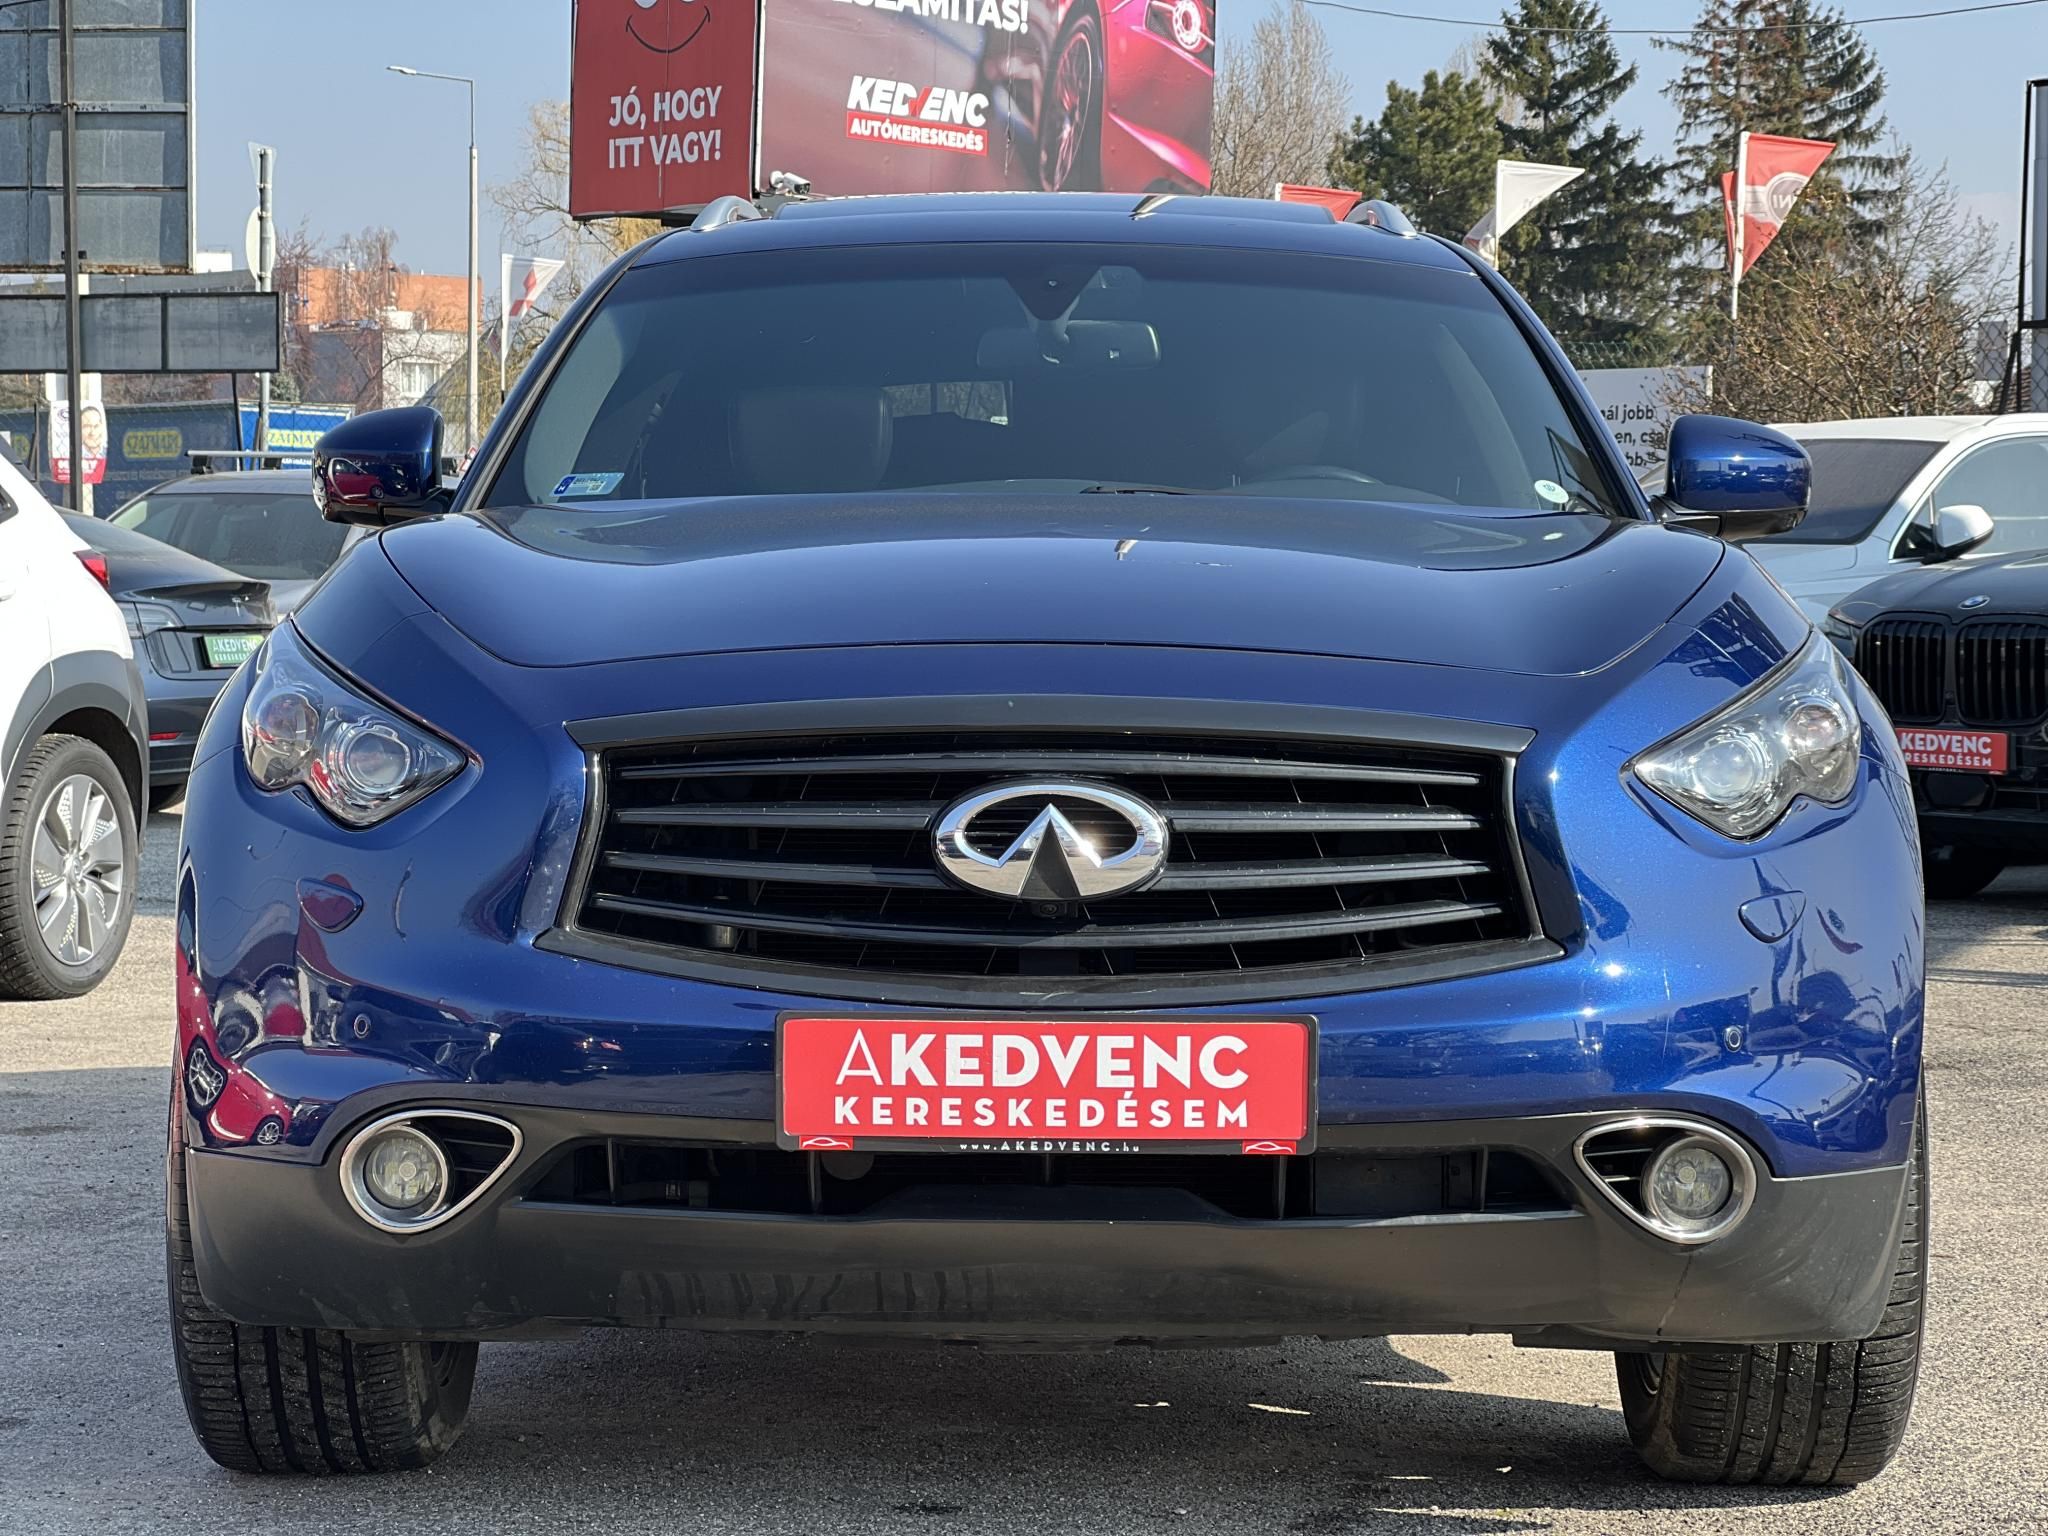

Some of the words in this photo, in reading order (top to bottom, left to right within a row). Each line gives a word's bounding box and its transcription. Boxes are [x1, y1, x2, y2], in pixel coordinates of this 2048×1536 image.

[609, 86, 646, 130] JÓ,
[653, 86, 722, 122] HOGY
[847, 75, 989, 127] KEDVENC
[609, 137, 644, 168] ITT
[650, 130, 721, 165] VAGY!
[851, 118, 984, 151] AUTÓKERESKEDÉS
[1621, 404, 1654, 424] jobb
[1902, 733, 1992, 754] KEDVENC
[835, 1028, 1249, 1089] AKEDVENC
[834, 1091, 1249, 1128] KERESKEDÉSEM
[960, 1141, 1140, 1152] www.AKEDVENC.hu
